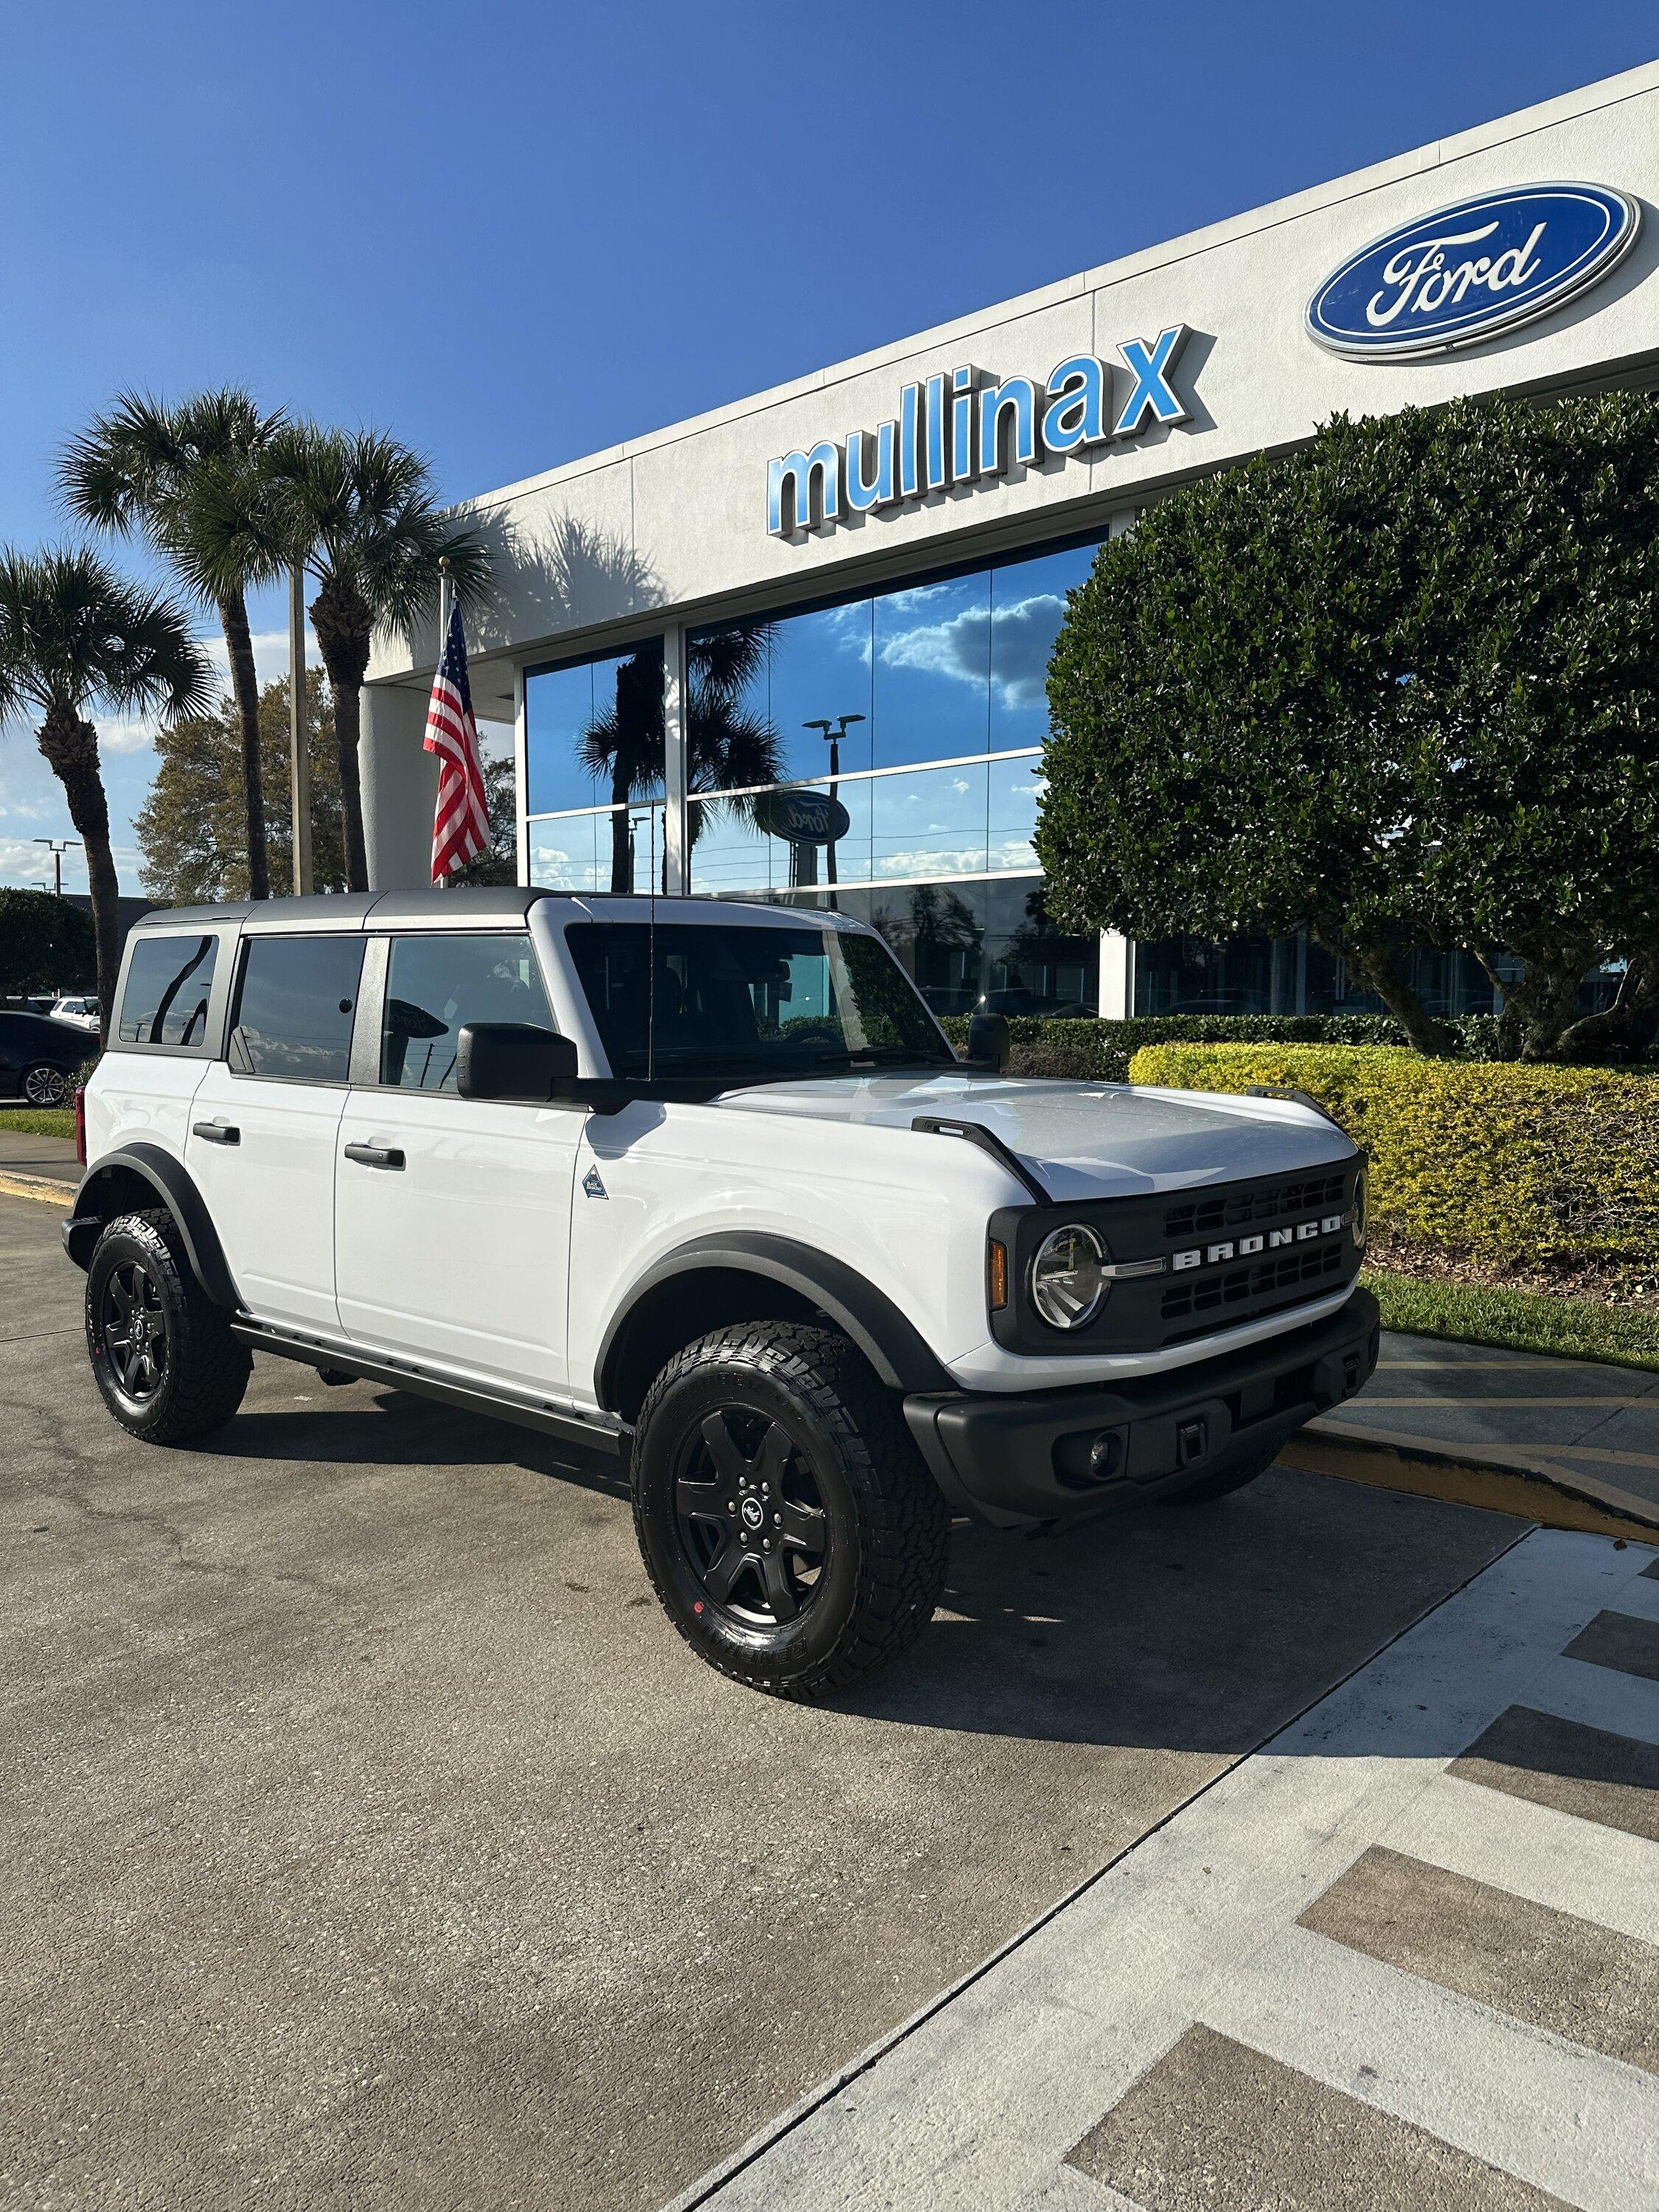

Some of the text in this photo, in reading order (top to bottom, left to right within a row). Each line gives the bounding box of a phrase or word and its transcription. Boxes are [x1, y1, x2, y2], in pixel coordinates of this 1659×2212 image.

[1366, 220, 1548, 327] Ford
[767, 323, 1189, 536] mullinax
[1172, 1215, 1341, 1270] BRONCO
